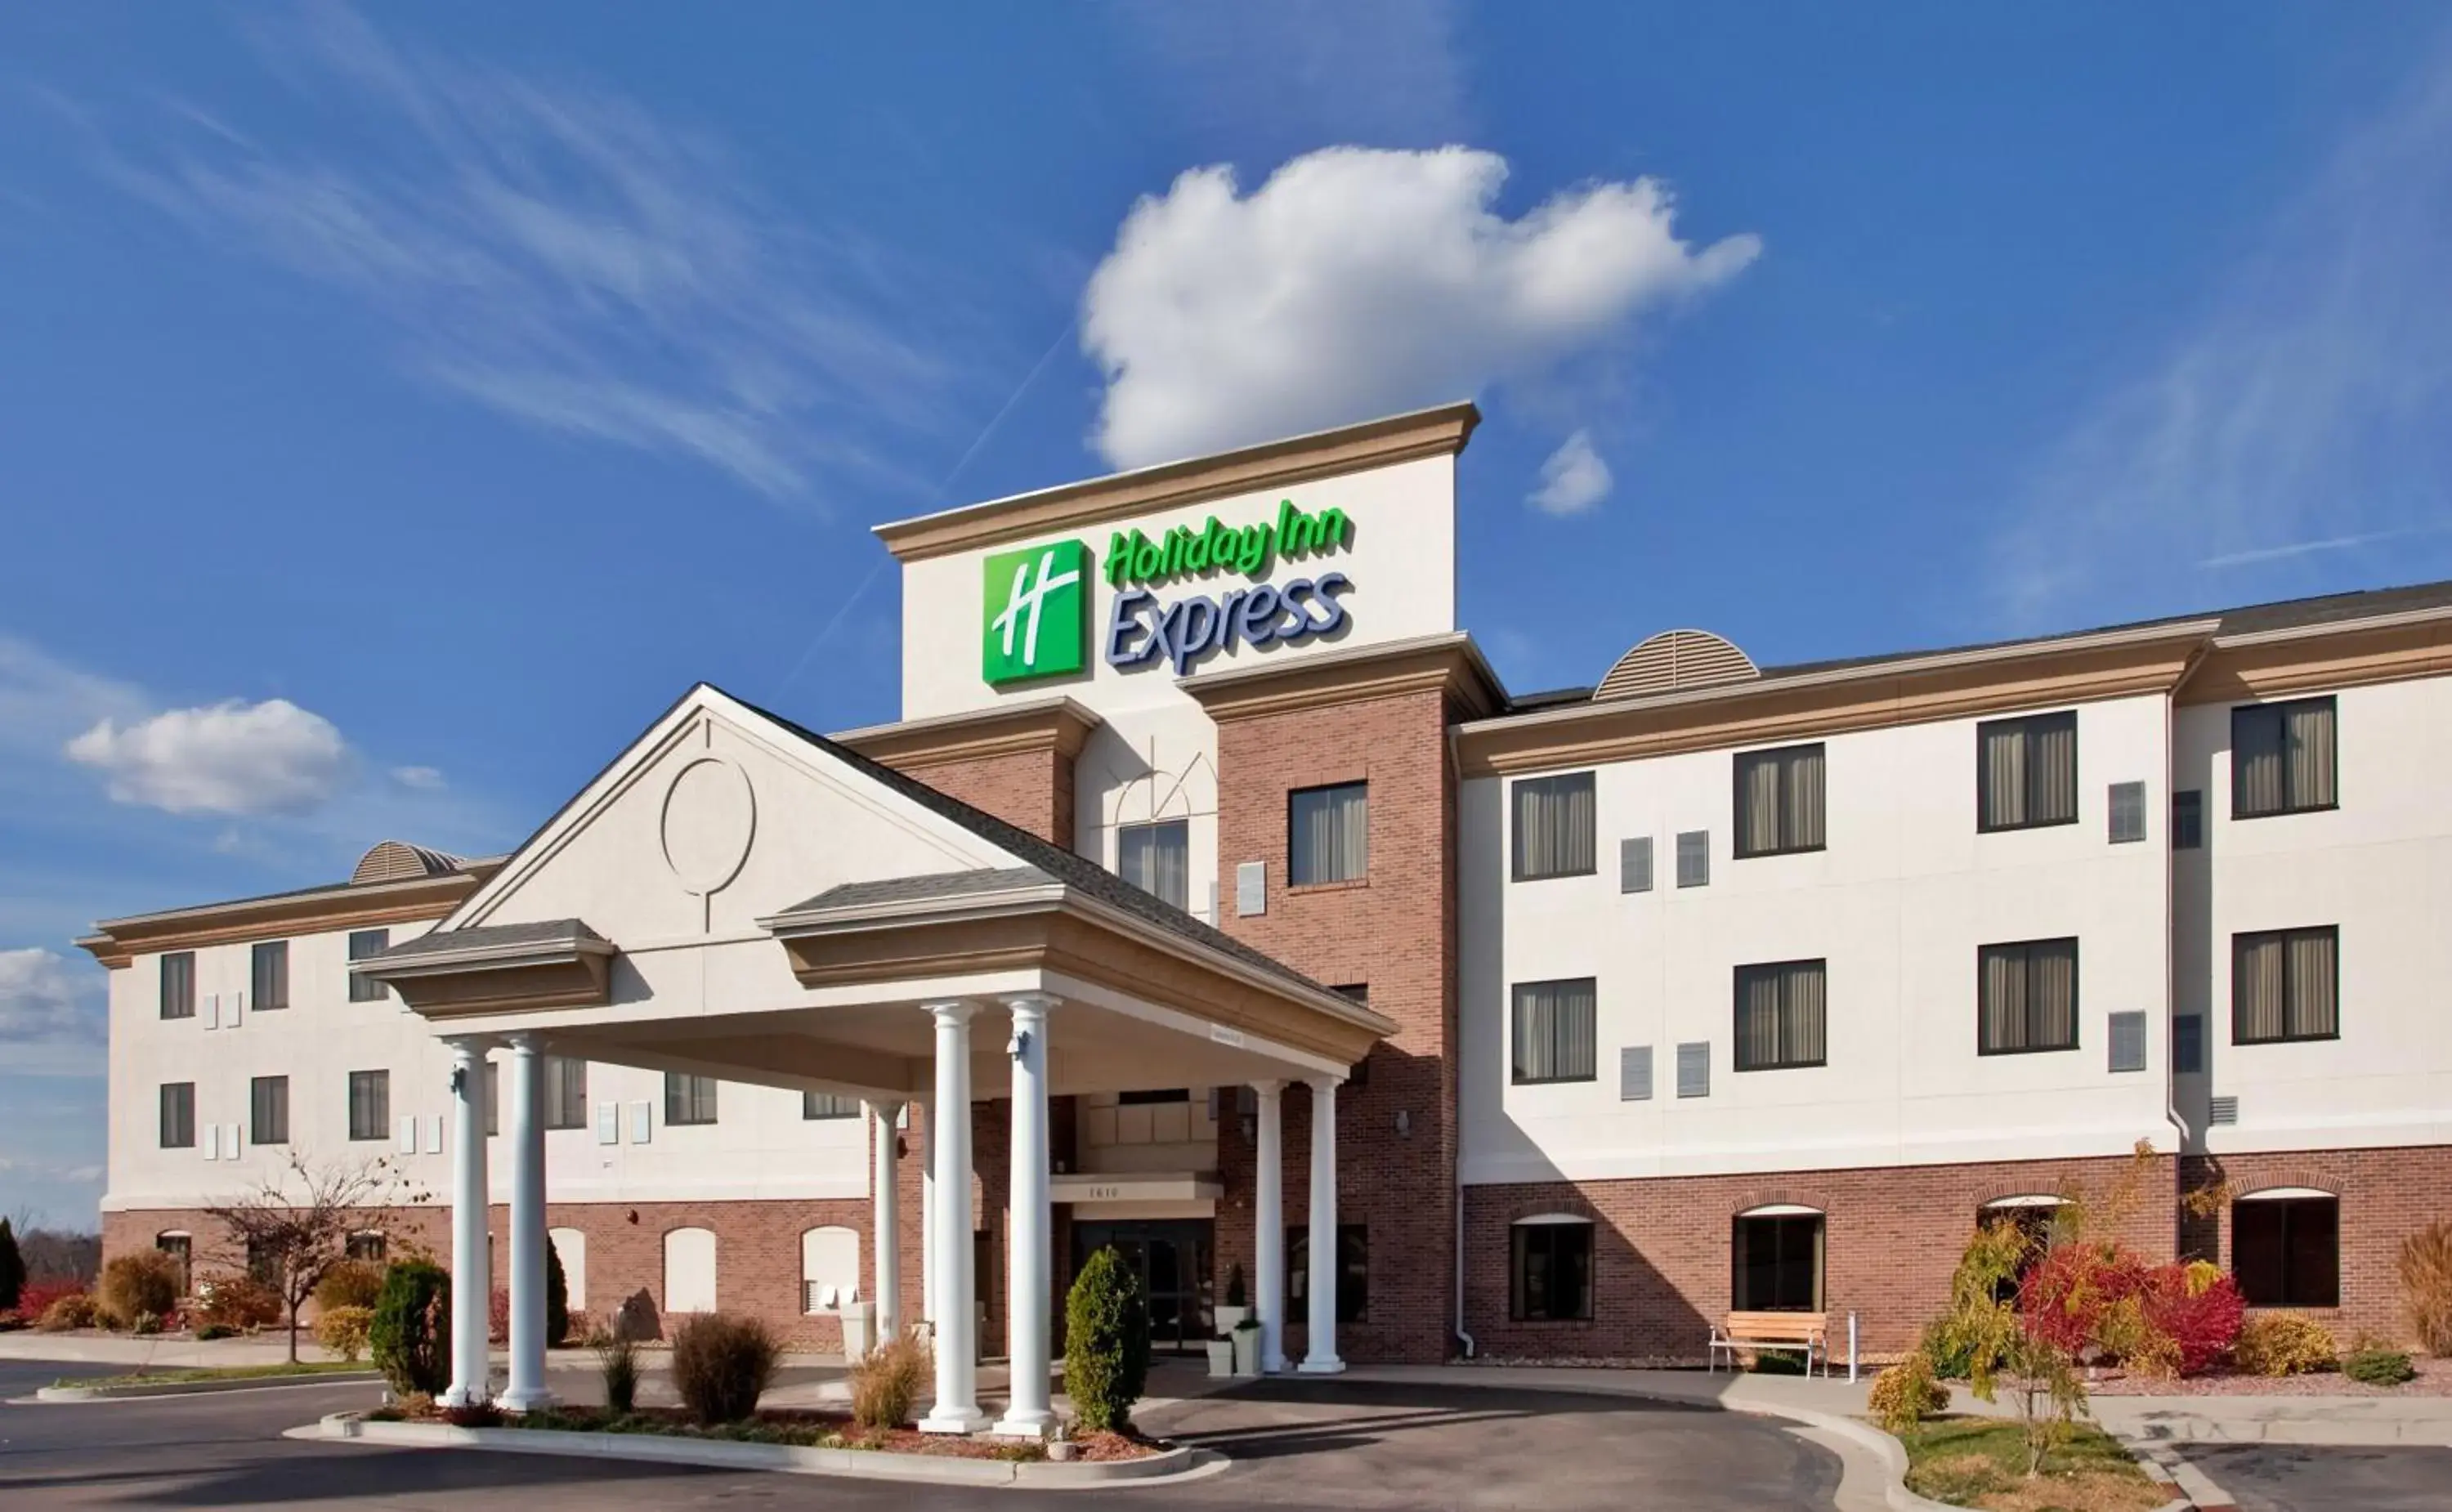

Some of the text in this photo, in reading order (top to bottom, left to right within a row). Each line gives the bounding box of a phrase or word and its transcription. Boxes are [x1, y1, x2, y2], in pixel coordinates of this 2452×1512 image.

[1104, 499, 1347, 583] Holiday Inn
[991, 550, 1079, 665] H
[1105, 572, 1349, 677] Express
[1090, 1187, 1118, 1198] 1610
